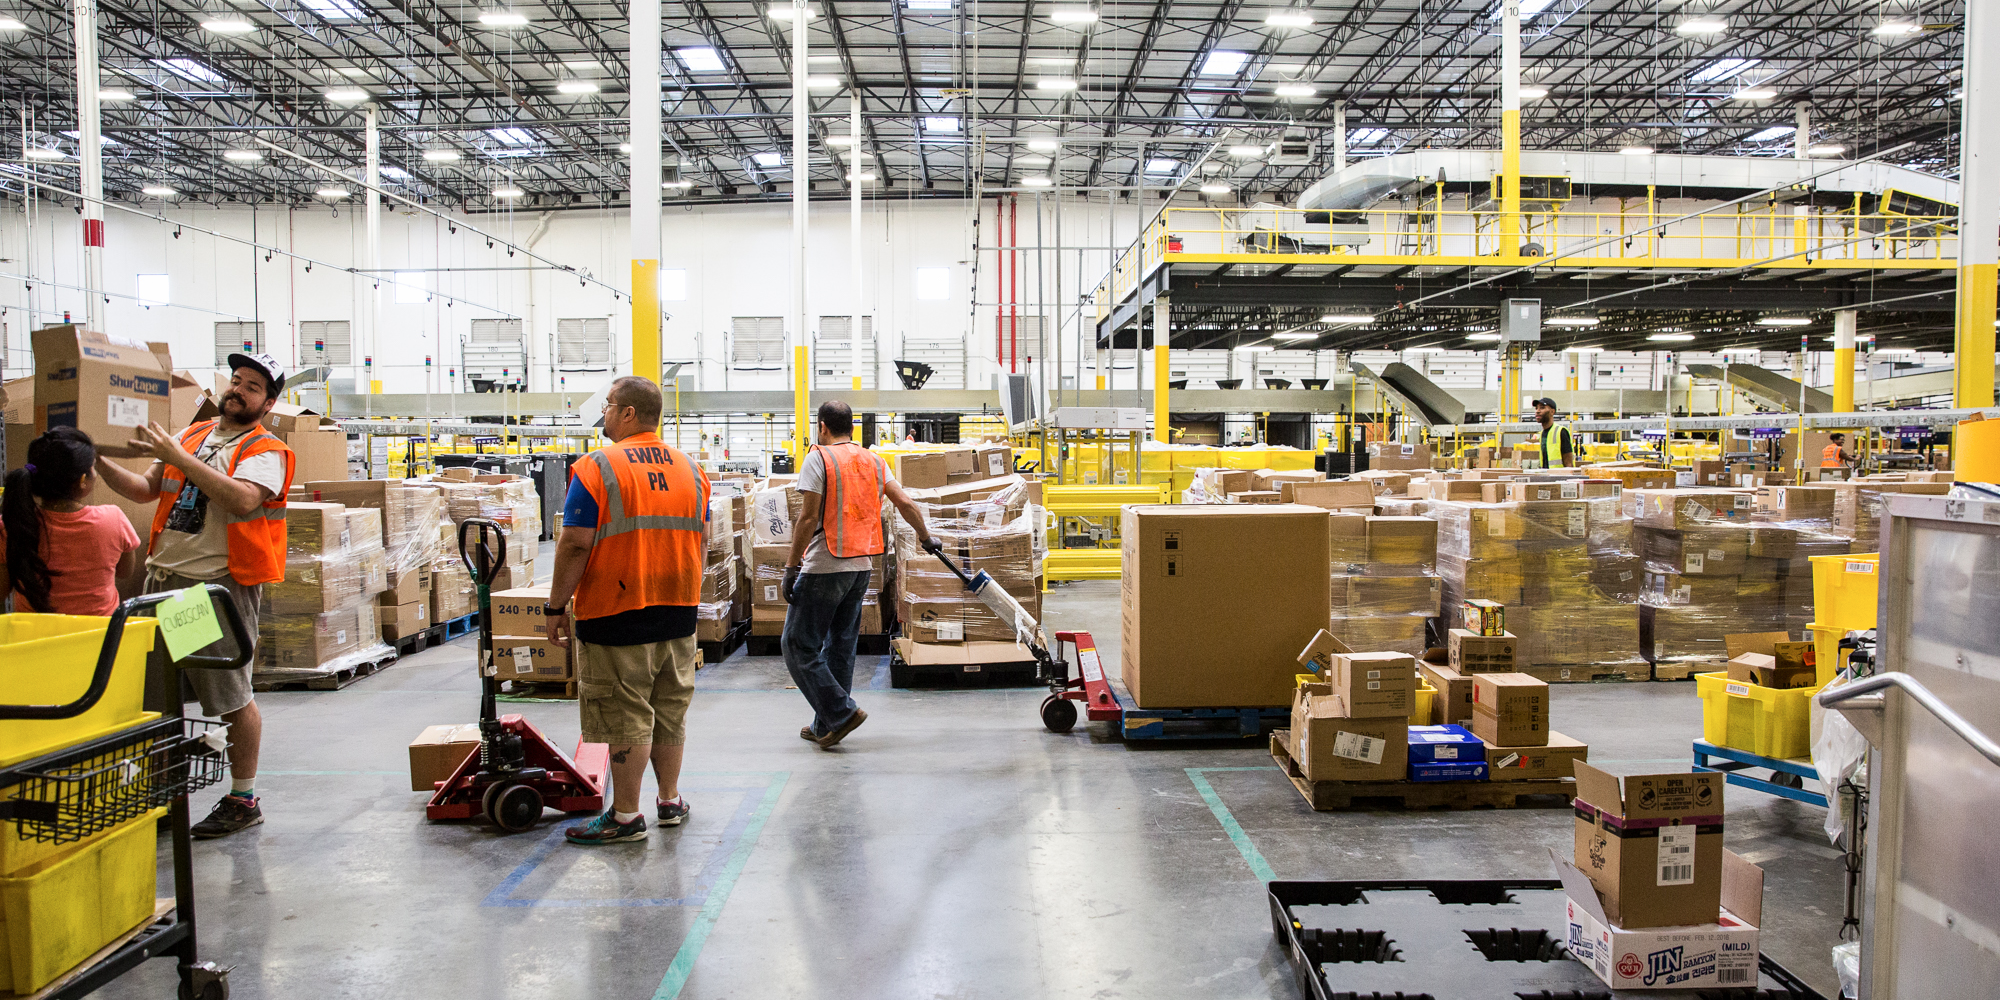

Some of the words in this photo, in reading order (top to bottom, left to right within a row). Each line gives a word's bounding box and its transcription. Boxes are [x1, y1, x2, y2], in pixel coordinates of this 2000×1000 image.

[1509, 7, 1518, 16] 10
[109, 374, 159, 394] Shurtape
[623, 447, 673, 465] EWR4
[647, 472, 669, 491] PA
[163, 601, 209, 633] CUBISCAN
[498, 605, 541, 615] 240-P6
[497, 648, 545, 658] 24P6
[1659, 786, 1692, 794] CAREFULLY
[1667, 779, 1684, 787] OPEN
[1722, 943, 1750, 951] (MILD)
[1643, 945, 1684, 986] JIN
[1683, 953, 1716, 969] RAMYON
[1692, 964, 1715, 978] 진라면
